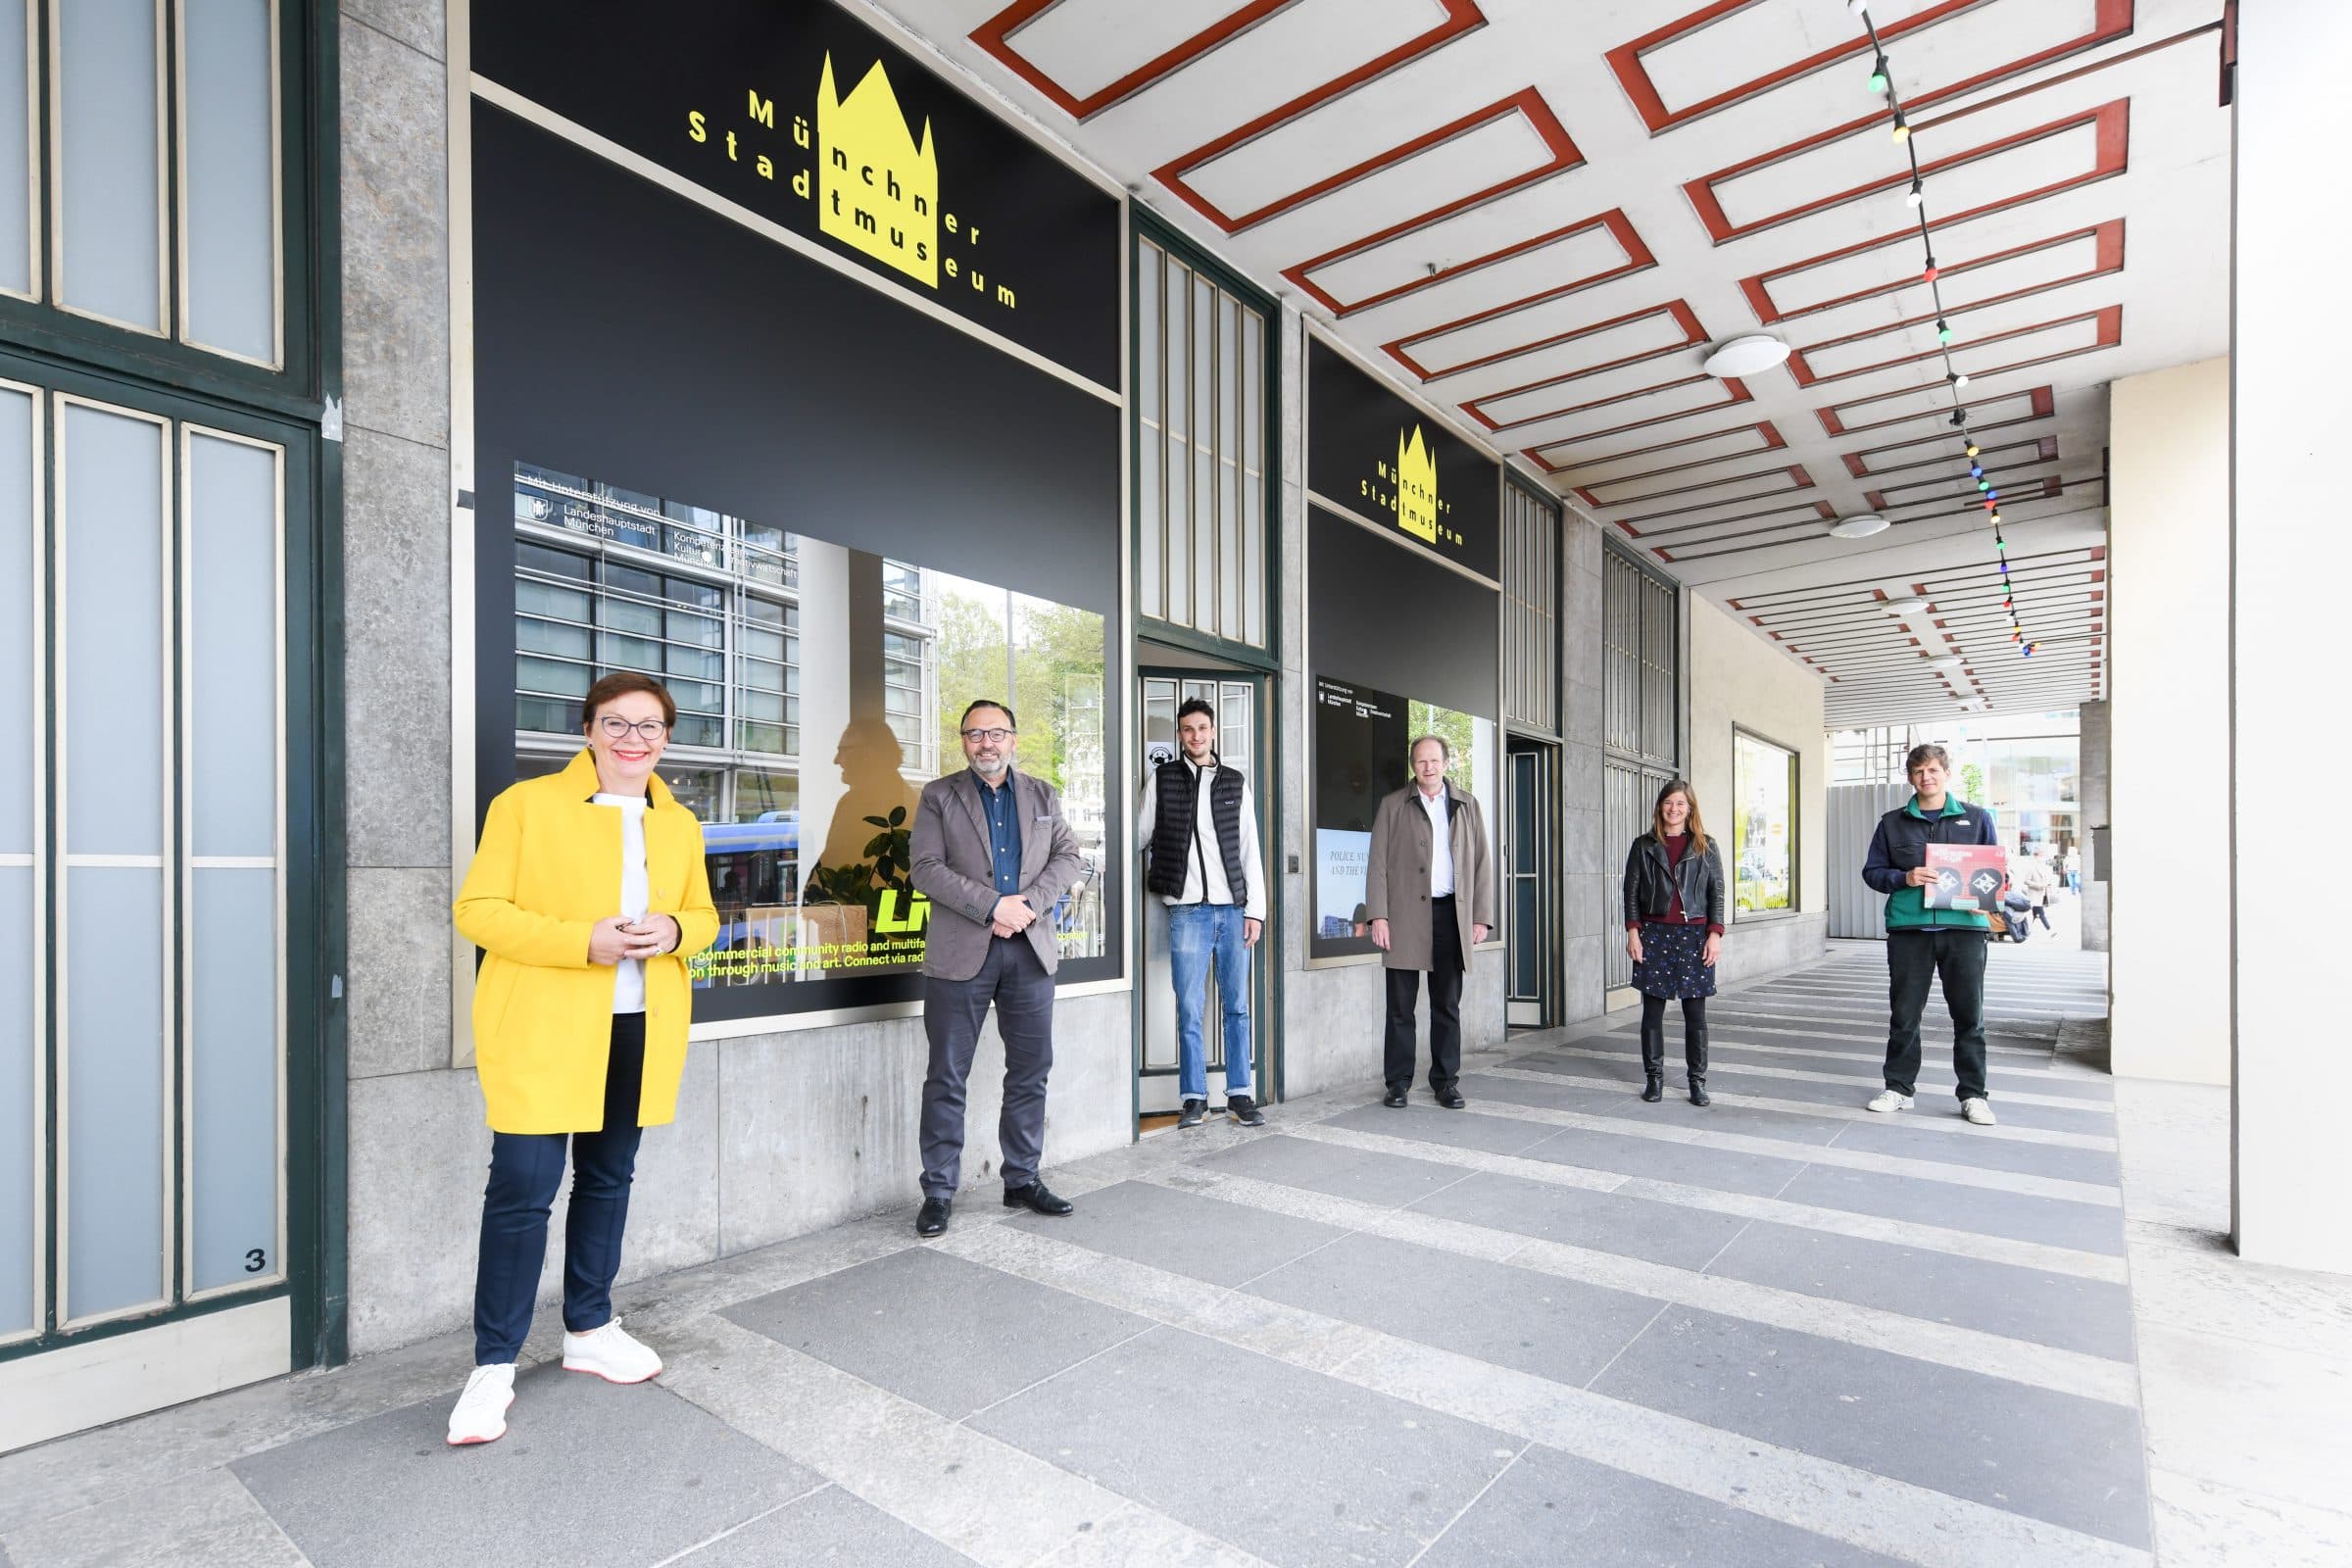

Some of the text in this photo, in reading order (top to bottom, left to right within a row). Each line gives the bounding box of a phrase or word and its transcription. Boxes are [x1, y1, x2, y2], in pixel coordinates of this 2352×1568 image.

[749, 89, 979, 244] Münchner
[689, 110, 1015, 309] Stadtmuseum
[1378, 461, 1450, 514] Münchner
[564, 505, 656, 536] Landeshauptstadt
[640, 505, 661, 516] von
[1360, 479, 1462, 546] Stadtmuseum
[564, 515, 614, 536] München
[673, 541, 702, 557] Kultur
[774, 941, 839, 957] community
[841, 940, 868, 954] radio
[870, 939, 890, 952] and
[708, 961, 758, 977] through
[760, 960, 797, 973] music
[799, 957, 821, 970] and
[822, 956, 842, 969] art.
[844, 955, 890, 966] Connect
[891, 953, 906, 963] via
[245, 1248, 266, 1273] 3
